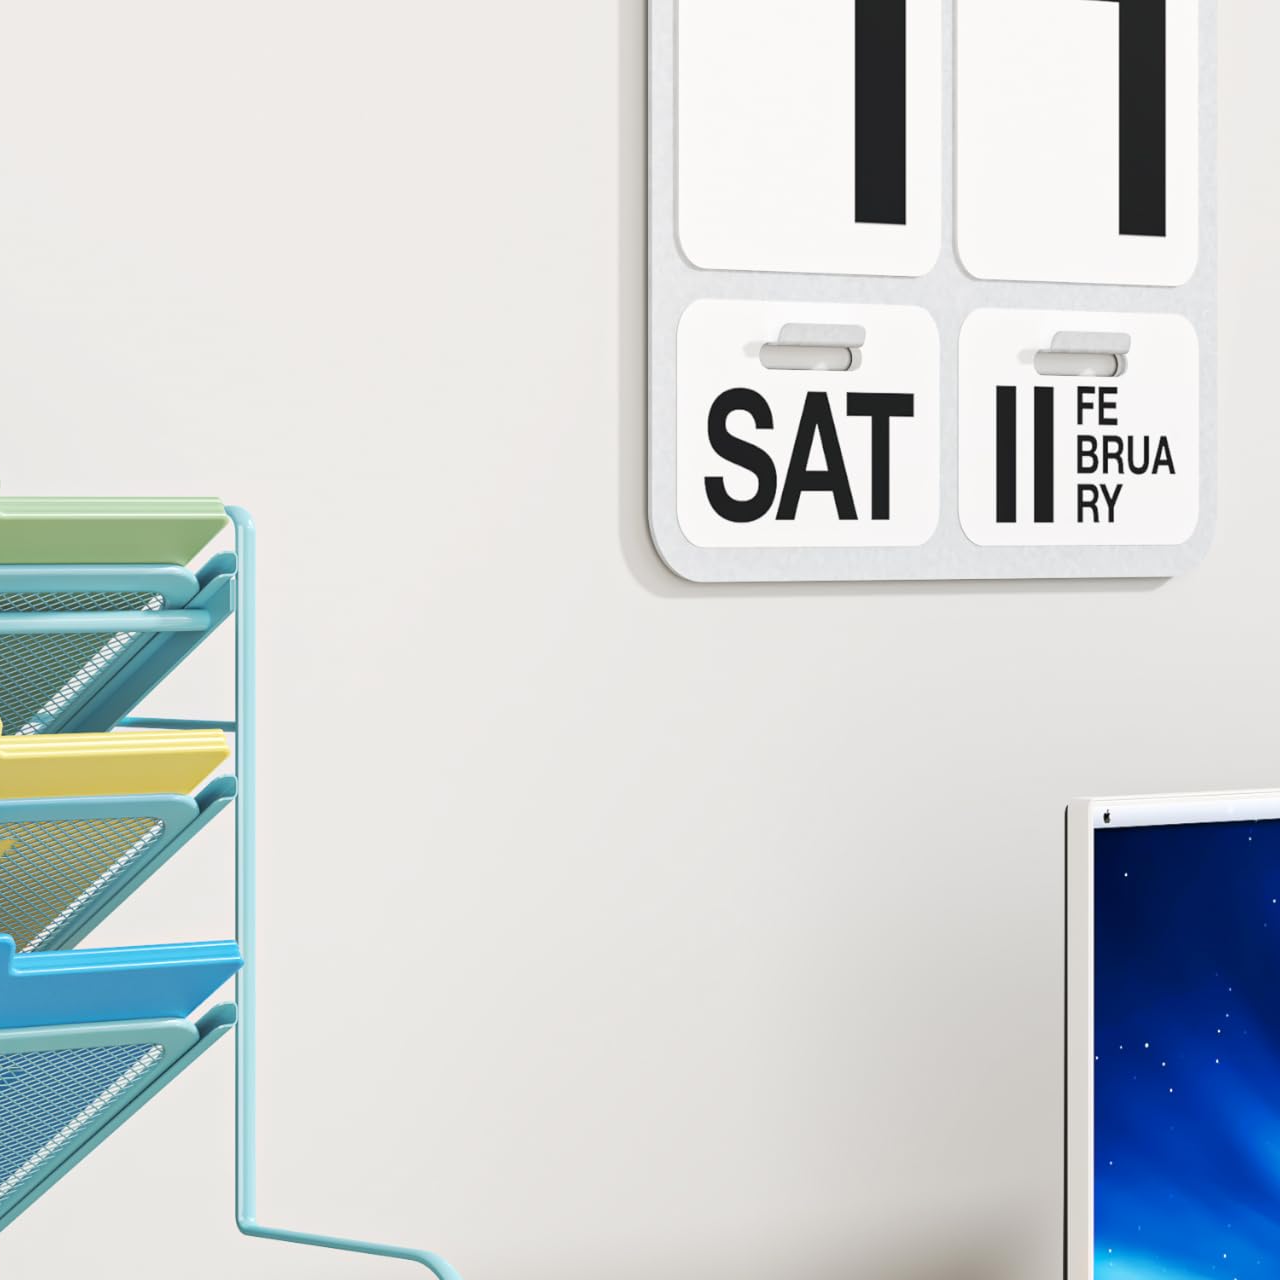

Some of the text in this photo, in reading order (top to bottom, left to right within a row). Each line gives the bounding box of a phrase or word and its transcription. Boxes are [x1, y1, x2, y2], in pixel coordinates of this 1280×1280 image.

[1076, 386, 1119, 426] FE
[704, 387, 915, 524] SAT
[1076, 435, 1176, 475] BRUA
[1076, 484, 1124, 524] RY
